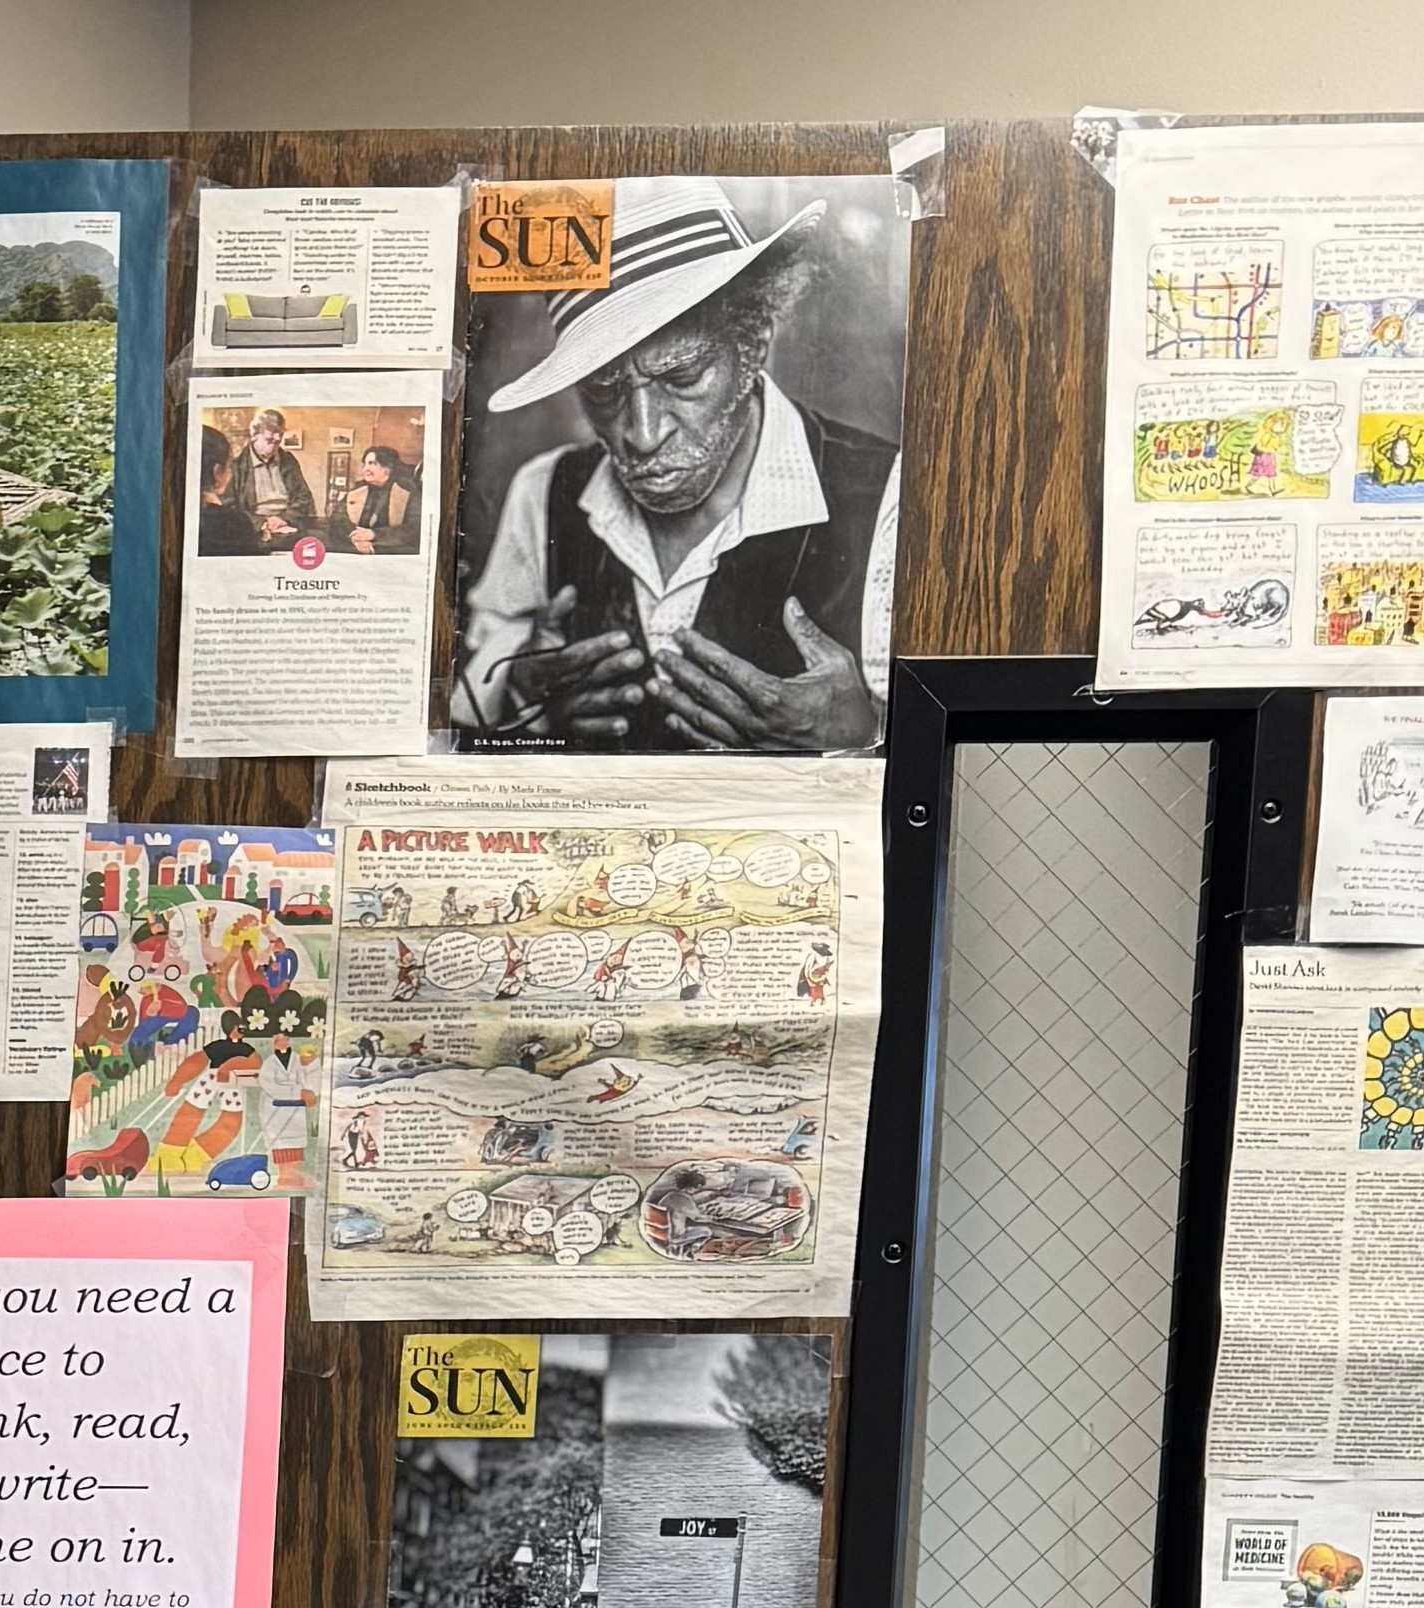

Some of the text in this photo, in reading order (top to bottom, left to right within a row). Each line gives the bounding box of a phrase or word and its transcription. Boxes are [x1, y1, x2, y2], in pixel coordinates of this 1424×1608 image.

[478, 194, 524, 215] The
[478, 214, 610, 268] SUN
[274, 576, 340, 590] Treasure
[354, 782, 430, 793] Sketchbook
[357, 829, 549, 854] A PICTURE WALK
[1250, 960, 1326, 979] Just Ask
[76, 1277, 192, 1315] need
[207, 1285, 236, 1314] a
[62, 1344, 105, 1377] to
[408, 1347, 454, 1367] The
[408, 1368, 535, 1416] SUN
[72, 1403, 191, 1445] read,
[679, 1520, 705, 1536] JOY
[50, 1534, 106, 1563] on
[122, 1526, 176, 1563] in.
[1274, 1538, 1288, 1550] OF
[1235, 1552, 1285, 1565] MEDICINE
[23, 1589, 51, 1607] do
[60, 1590, 96, 1608] not
[104, 1589, 160, 1608] have
[169, 1591, 190, 1608] to
